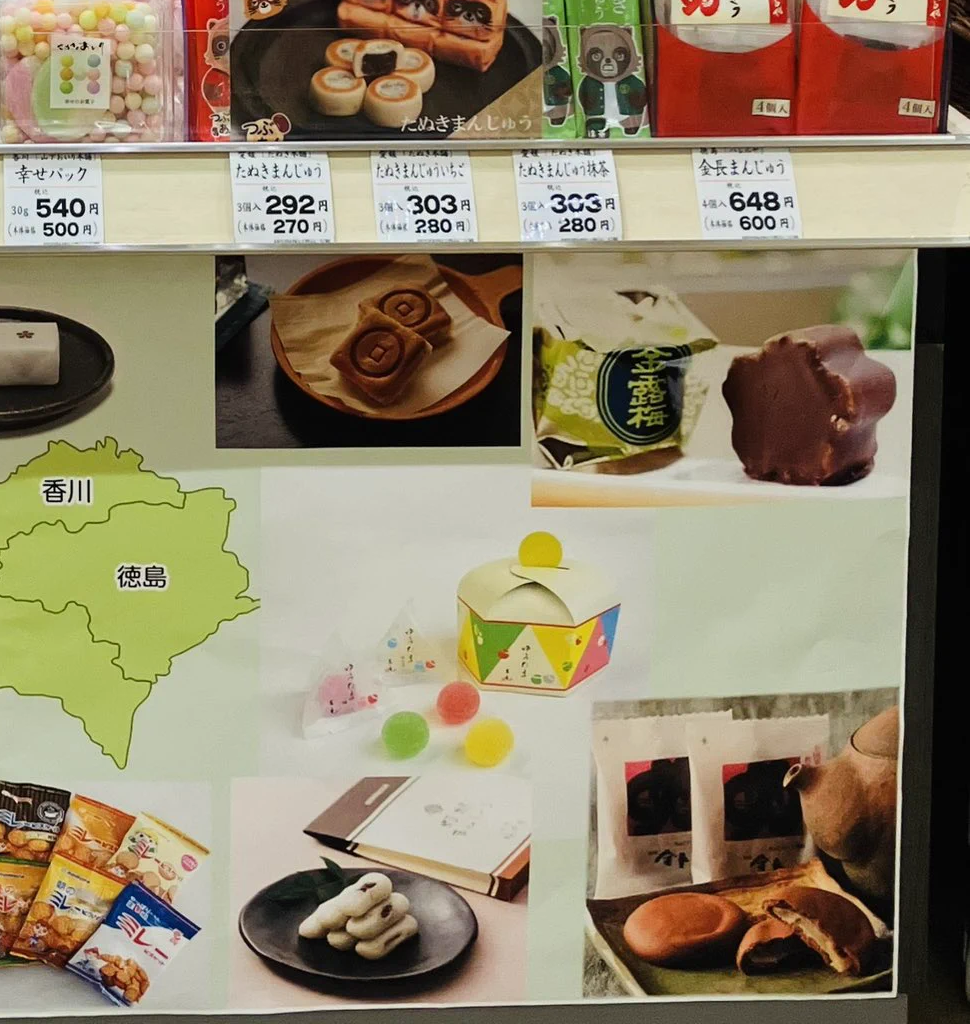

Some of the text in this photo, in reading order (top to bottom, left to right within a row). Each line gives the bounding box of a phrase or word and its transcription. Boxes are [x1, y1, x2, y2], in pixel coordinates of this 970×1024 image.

[400, 114, 534, 133] たぬきまんじゅう
[15, 166, 88, 183] 幸せパック
[236, 163, 322, 179] たぬきまんじゅう
[376, 162, 465, 179] たぬきまんじゅういちご
[518, 160, 610, 178] たぬきまんじゅう抹茶
[698, 158, 785, 177] 金長まんじゅう
[11, 205, 29, 217] 30g
[42, 478, 92, 504] 香川
[117, 564, 168, 591] 徳島
